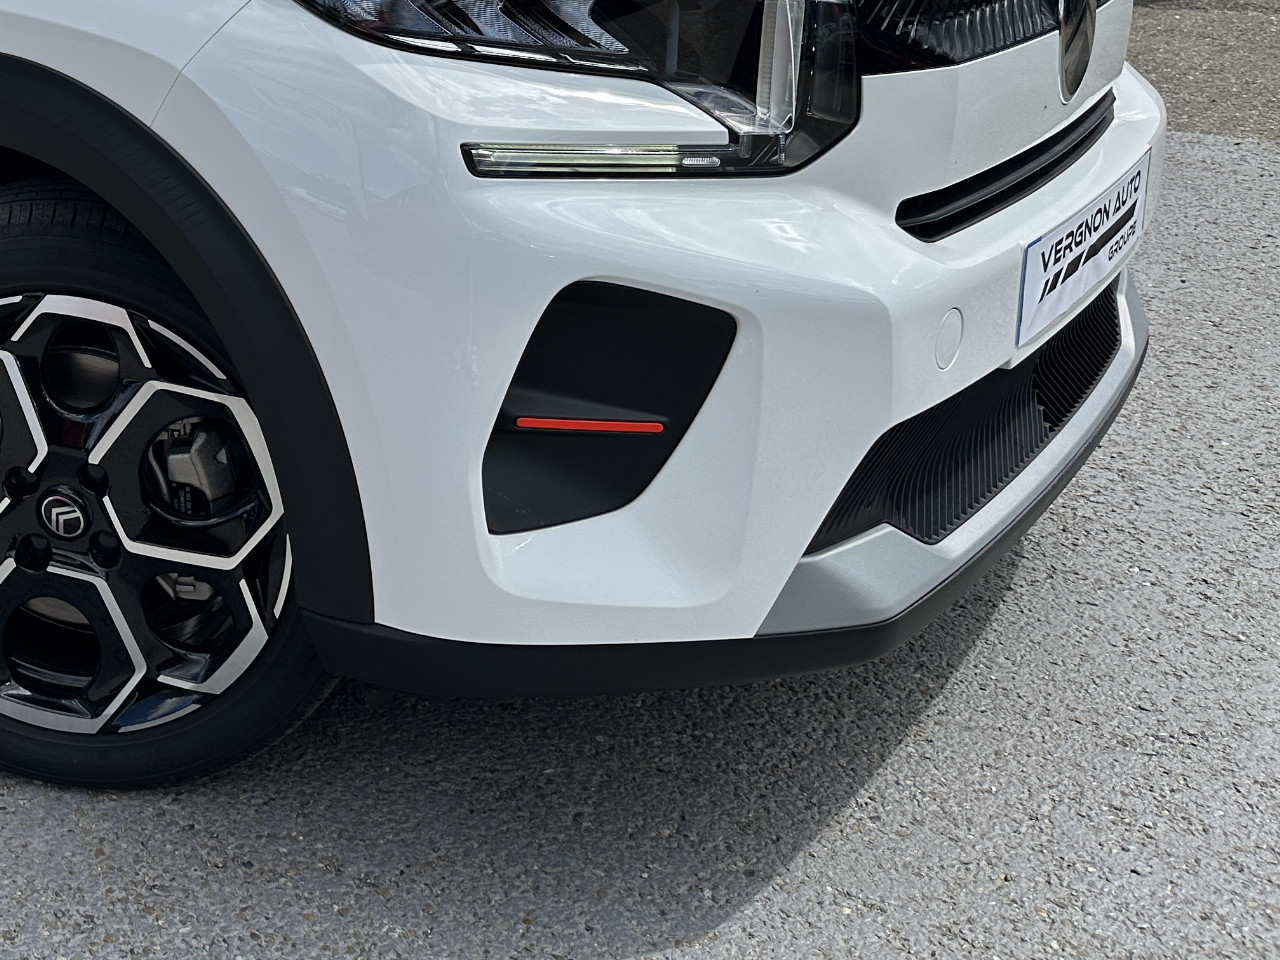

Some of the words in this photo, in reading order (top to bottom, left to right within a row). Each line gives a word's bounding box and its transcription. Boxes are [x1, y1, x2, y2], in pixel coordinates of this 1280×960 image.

[1041, 204, 1111, 272] VERGNON
[1113, 170, 1141, 216] AUTO
[1108, 220, 1137, 261] GROUPE
